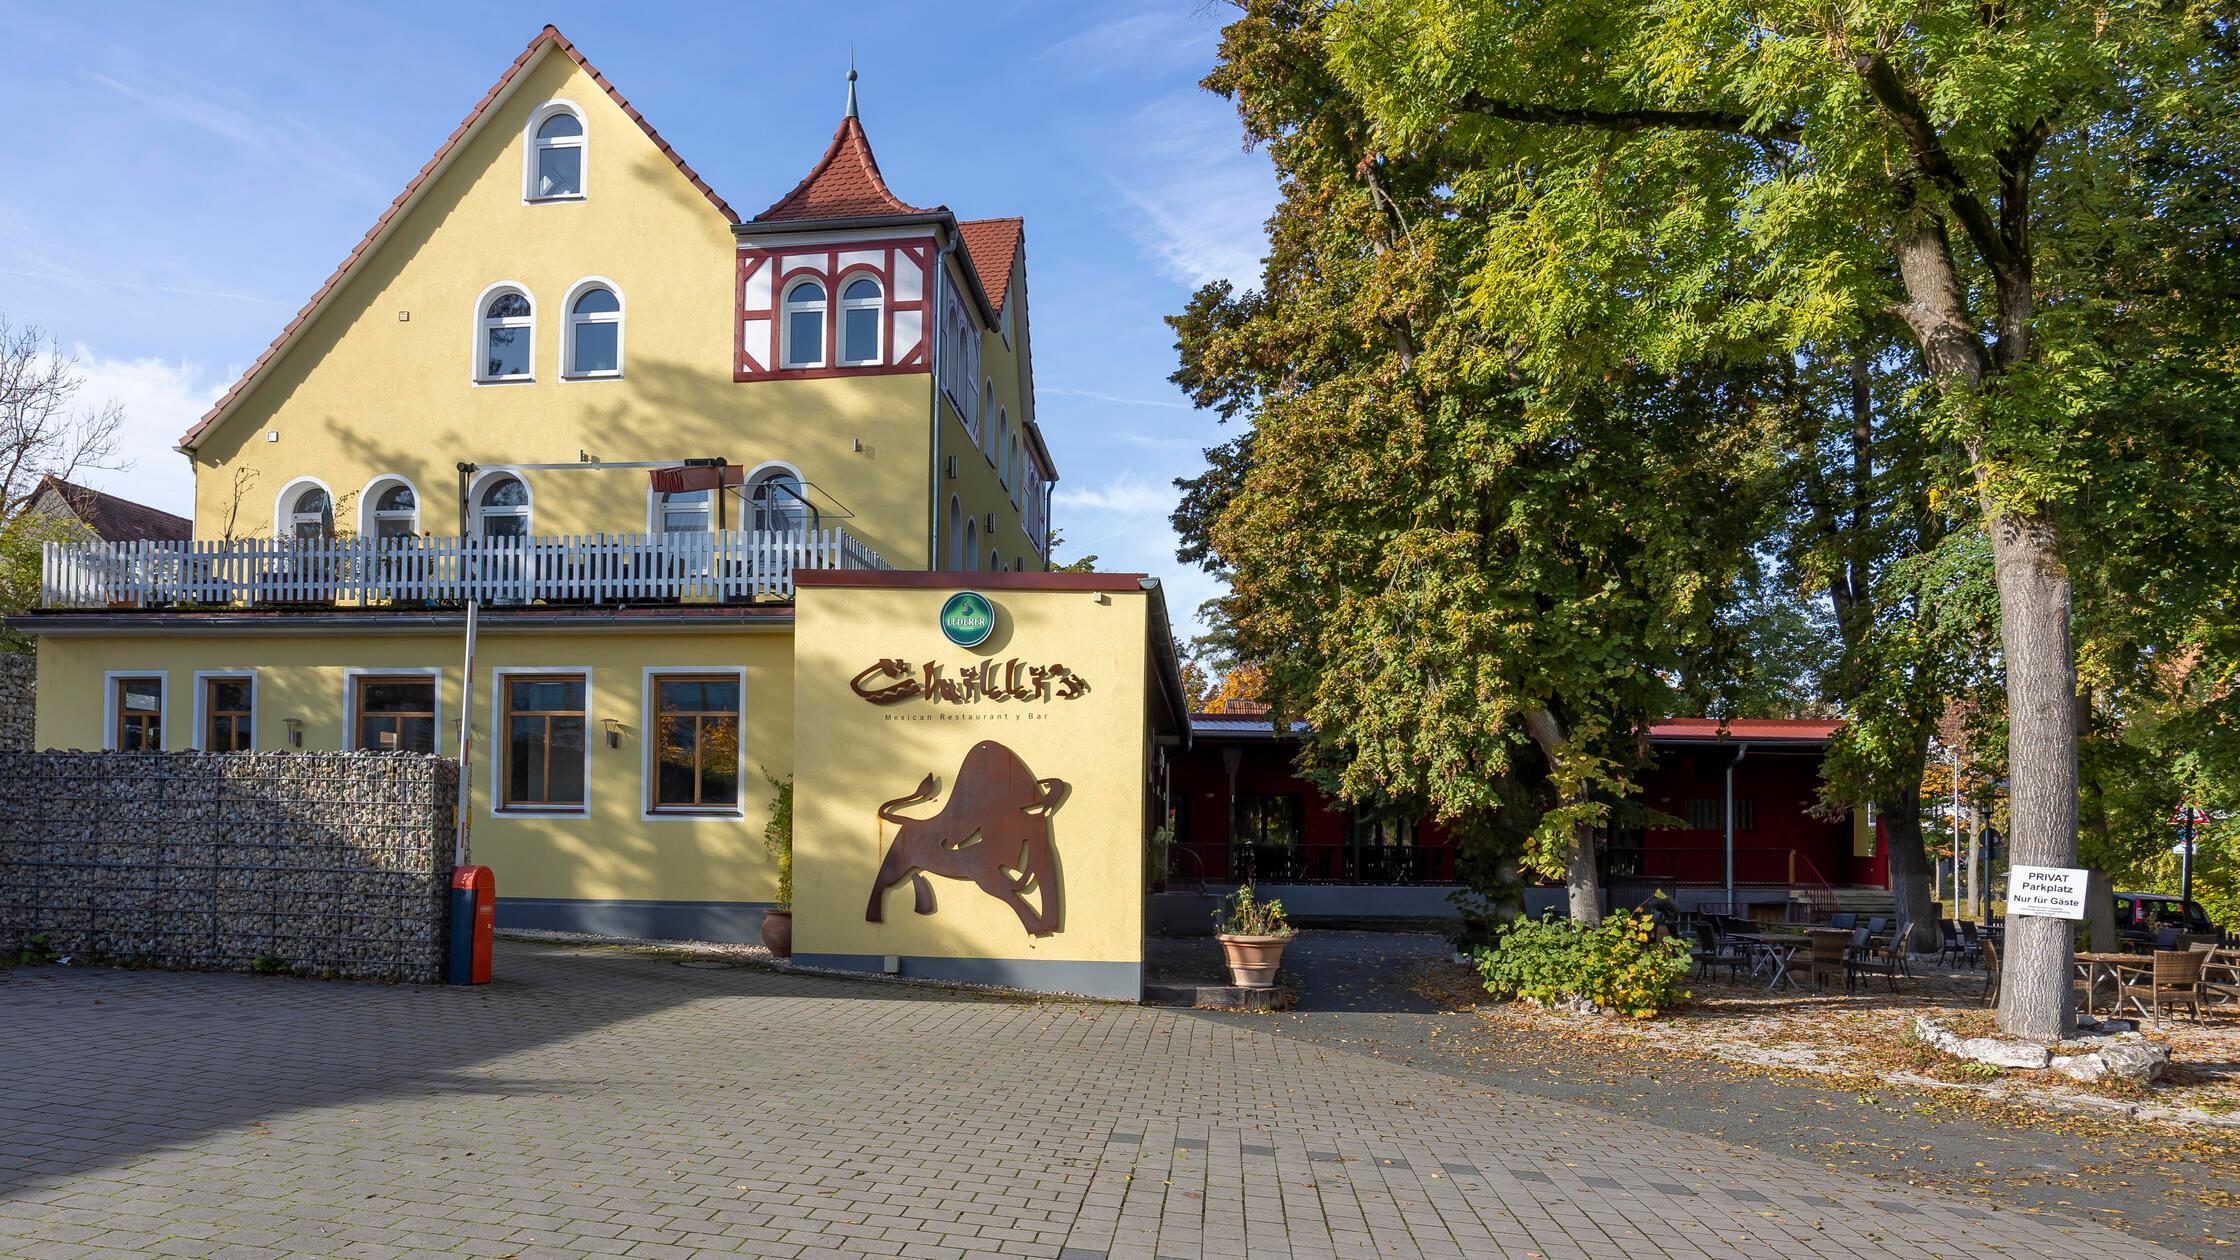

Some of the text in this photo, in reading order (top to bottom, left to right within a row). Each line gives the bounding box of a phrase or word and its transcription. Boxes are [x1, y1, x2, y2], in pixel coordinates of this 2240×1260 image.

[947, 617, 985, 626] LEDERER
[885, 713, 932, 721] Mexican
[940, 713, 1008, 721] Restaurant
[1028, 712, 1048, 720] Bar
[2028, 872, 2069, 882] PRIVAT
[2022, 882, 2073, 893] Parkplatz
[2014, 895, 2079, 907] Nur für Gäste
